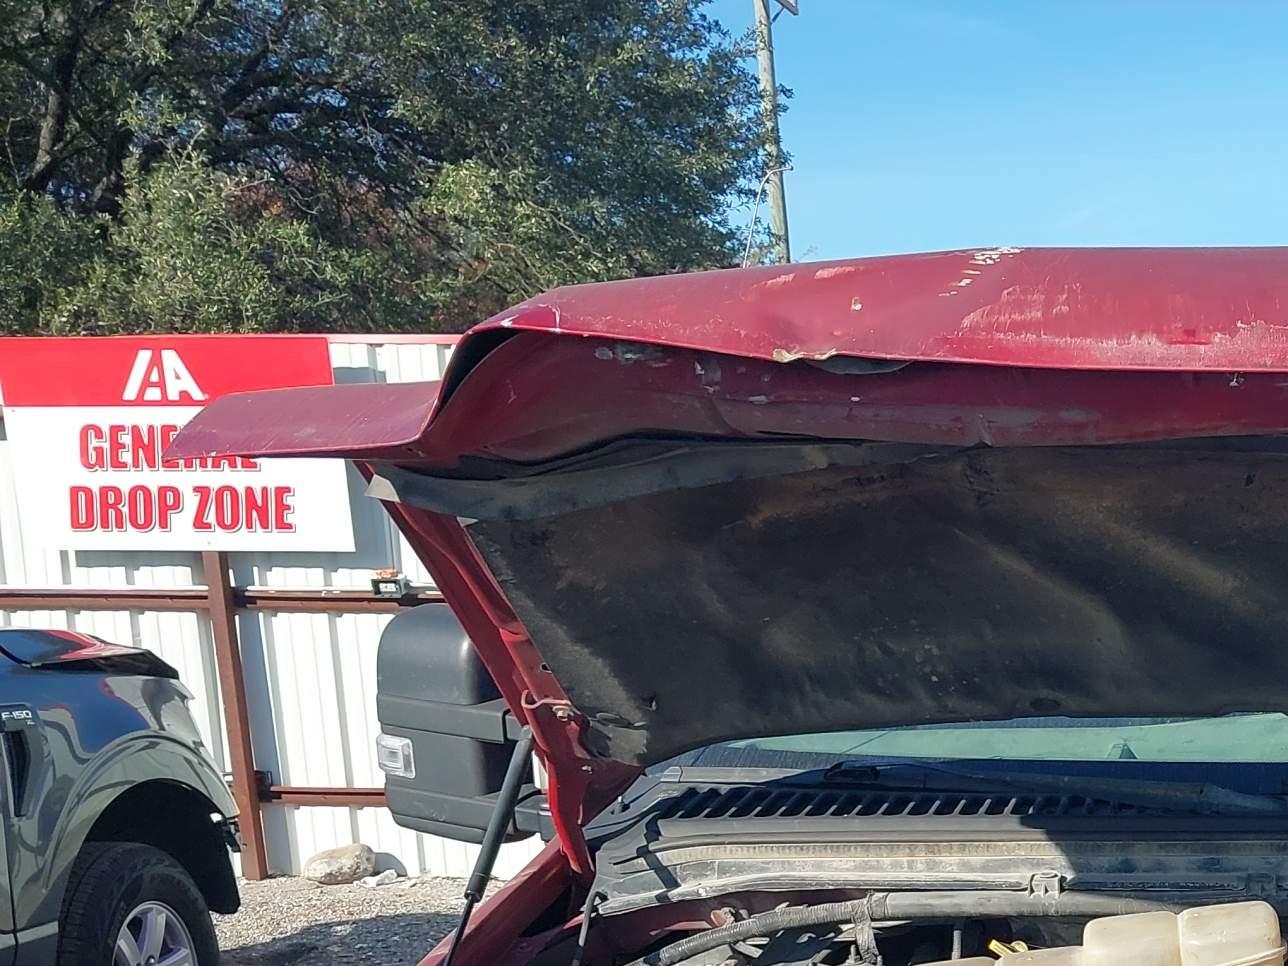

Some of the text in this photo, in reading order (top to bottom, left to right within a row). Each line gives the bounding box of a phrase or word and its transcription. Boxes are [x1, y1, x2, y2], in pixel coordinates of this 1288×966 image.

[122, 348, 207, 401] IAA
[69, 485, 297, 533] DROP ZONE
[1, 710, 32, 720] F-150
